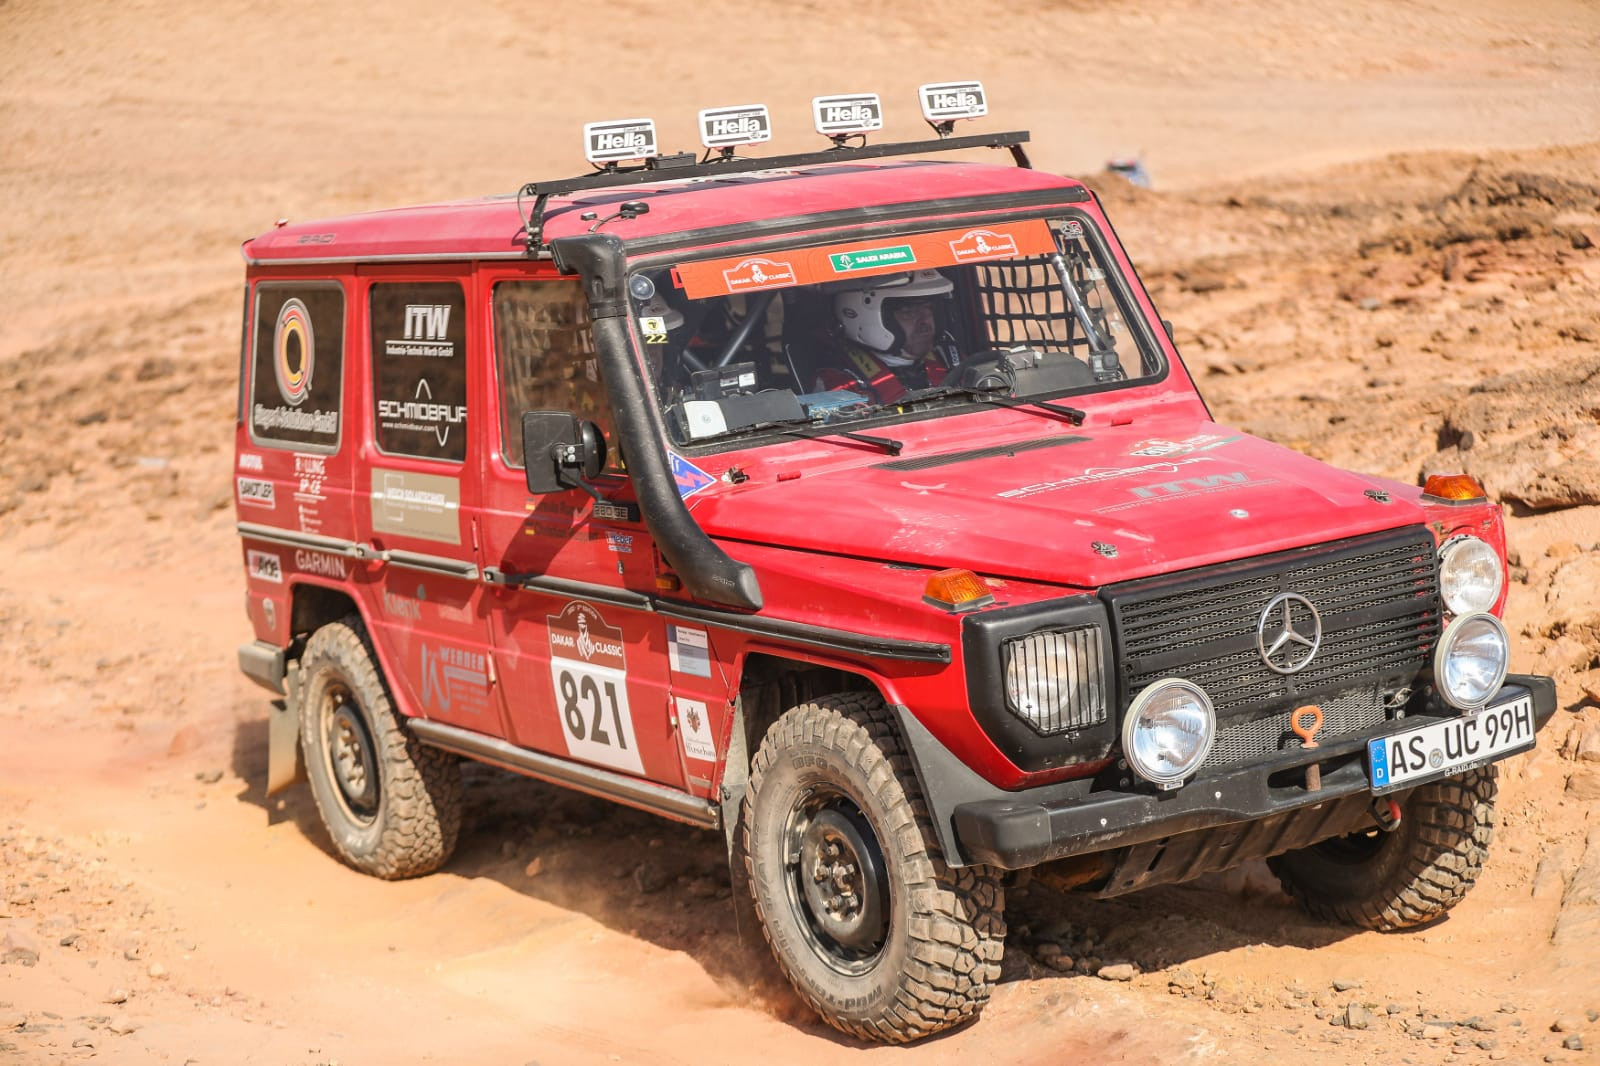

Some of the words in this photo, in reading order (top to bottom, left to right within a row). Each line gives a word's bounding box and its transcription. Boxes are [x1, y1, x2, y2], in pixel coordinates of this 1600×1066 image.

[934, 92, 977, 109] Hella
[827, 105, 873, 122] Hella
[713, 116, 760, 136] Hella
[597, 132, 646, 150] Hella
[855, 254, 879, 264] SAUDI
[879, 251, 908, 260] ARABIA
[403, 304, 451, 340] ITW
[645, 333, 669, 345] 22
[1128, 471, 1248, 498] ITW
[295, 549, 346, 579] GARMIN
[551, 632, 575, 648] DAKAR
[595, 642, 623, 657] CLASSIC
[560, 669, 628, 750] 821
[1376, 767, 1384, 779] D
[1390, 735, 1426, 778] AS
[1444, 719, 1480, 760] UC
[1485, 702, 1531, 749] 99H
[1444, 760, 1478, 777] G-RAID.de
